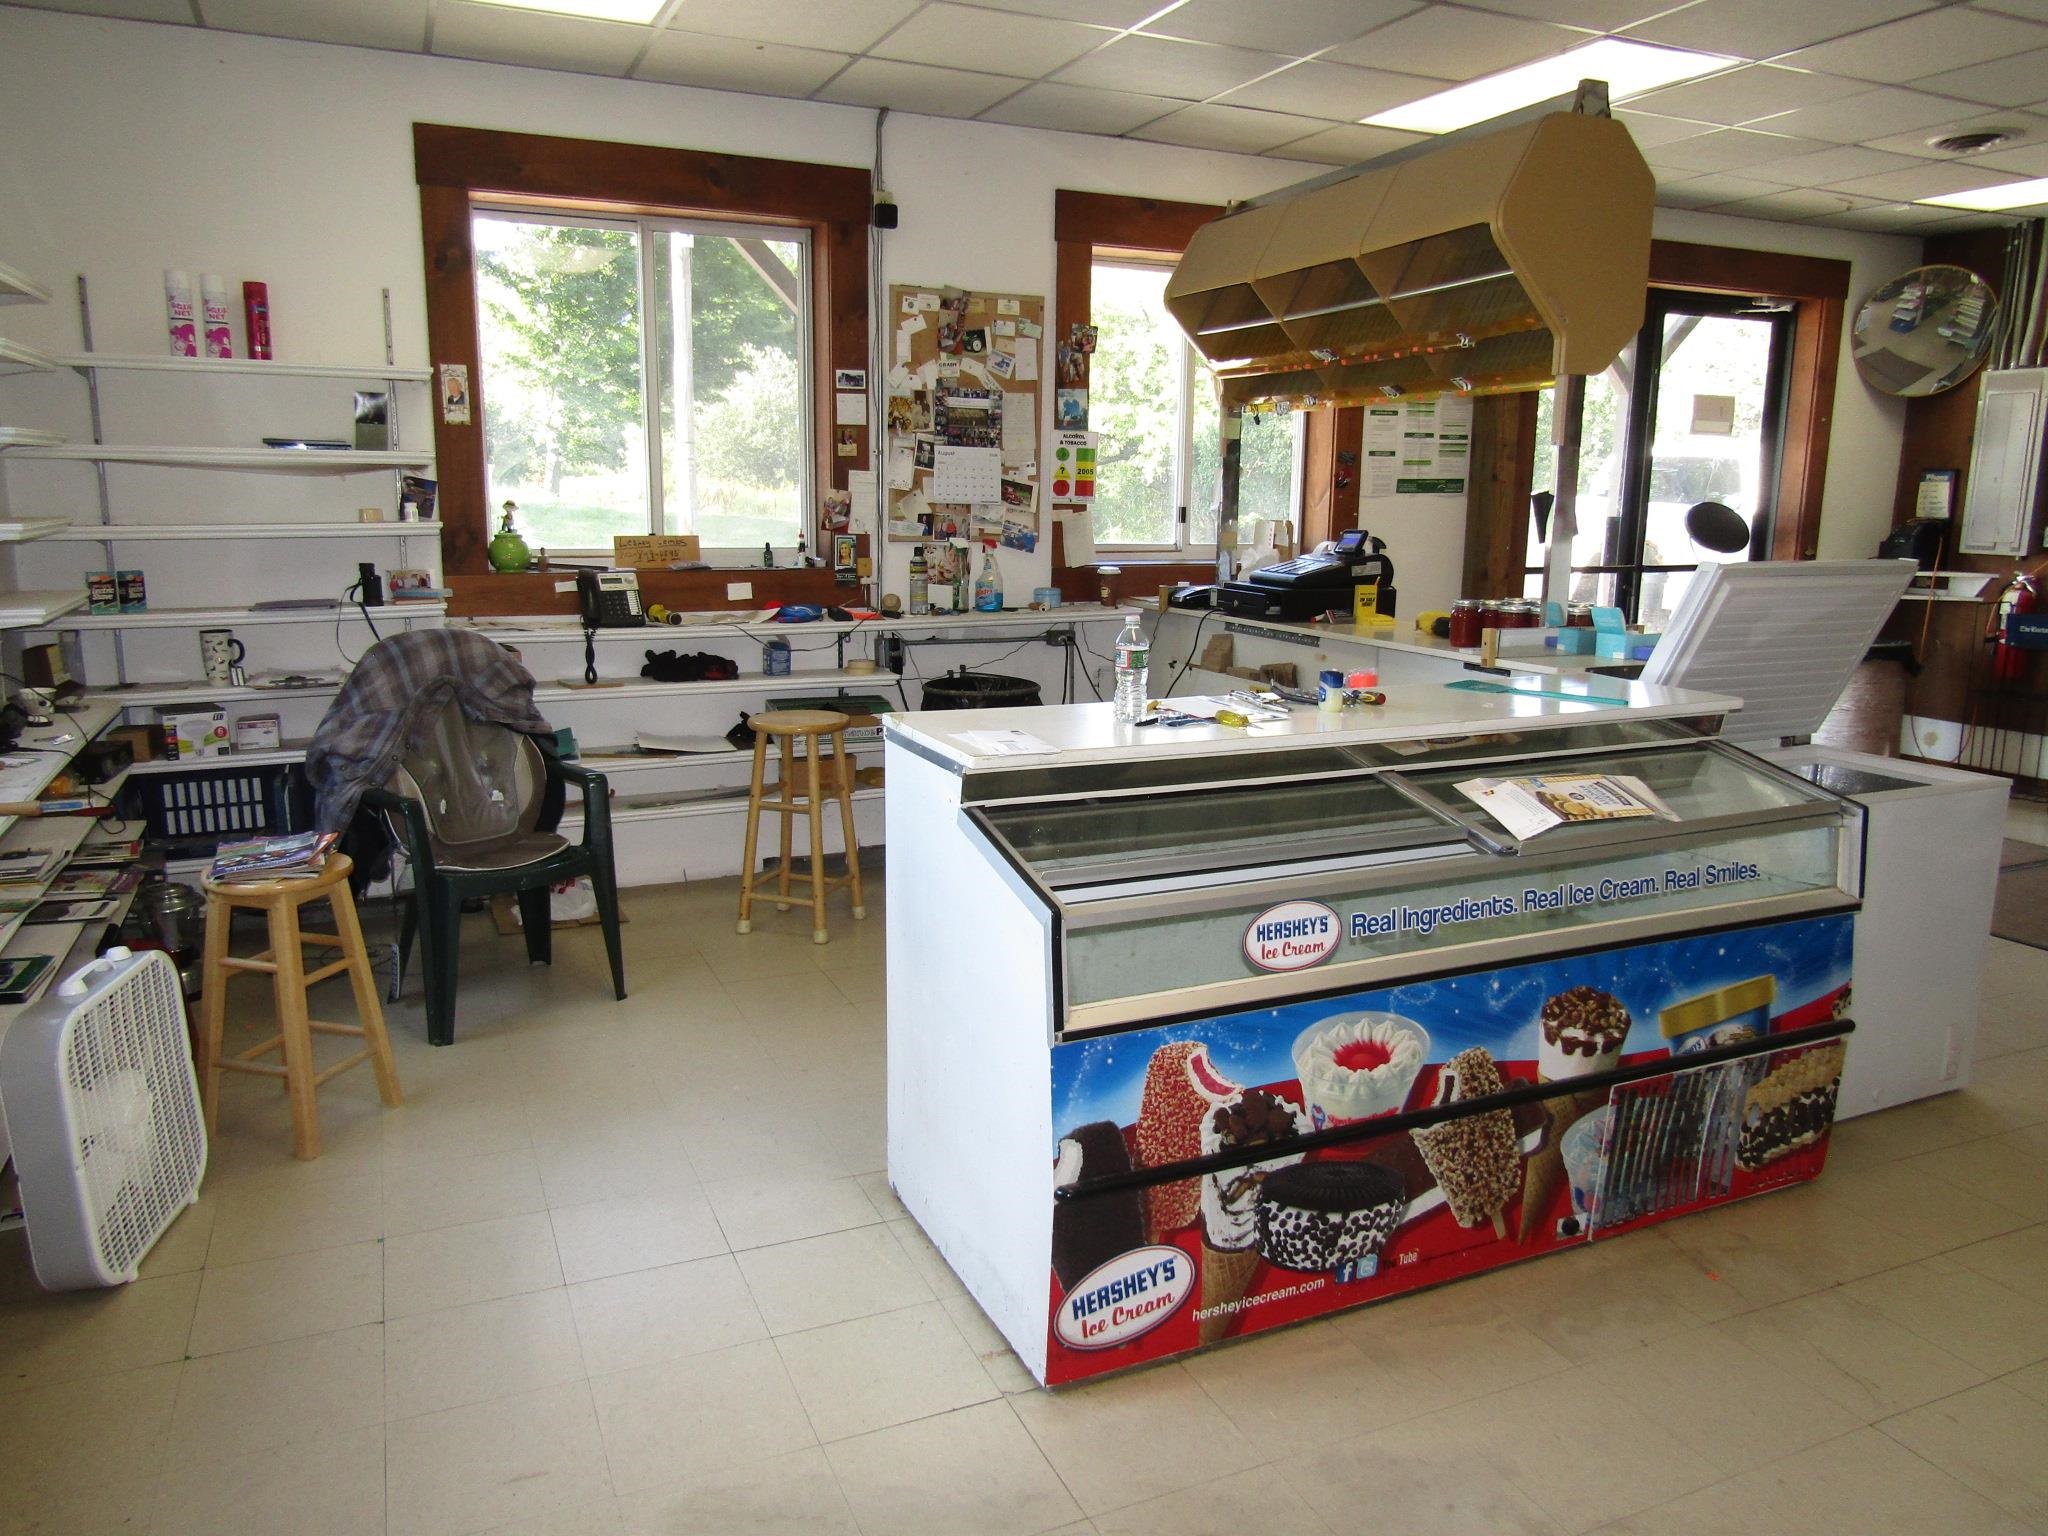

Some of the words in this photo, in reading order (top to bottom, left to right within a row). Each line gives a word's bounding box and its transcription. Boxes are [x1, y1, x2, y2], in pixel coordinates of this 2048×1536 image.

[1351, 908, 1396, 937] Real
[1402, 895, 1518, 935] Ingredients.
[1523, 886, 1563, 912] Real
[1568, 884, 1594, 906] Ice
[1600, 877, 1659, 900] Cream.
[1664, 867, 1700, 891] Real
[1705, 861, 1760, 885] Smiles.
[1257, 915, 1328, 942] HERSHEY'S
[1261, 943, 1279, 960] Ice
[1282, 941, 1325, 957] Cream
[1399, 1250, 1418, 1265] Tube
[1071, 1257, 1176, 1320] HERSHEY'S
[1192, 1278, 1325, 1321] hersheyicecream.com
[1082, 1319, 1108, 1338] Ice
[1112, 1292, 1175, 1326] Cream
